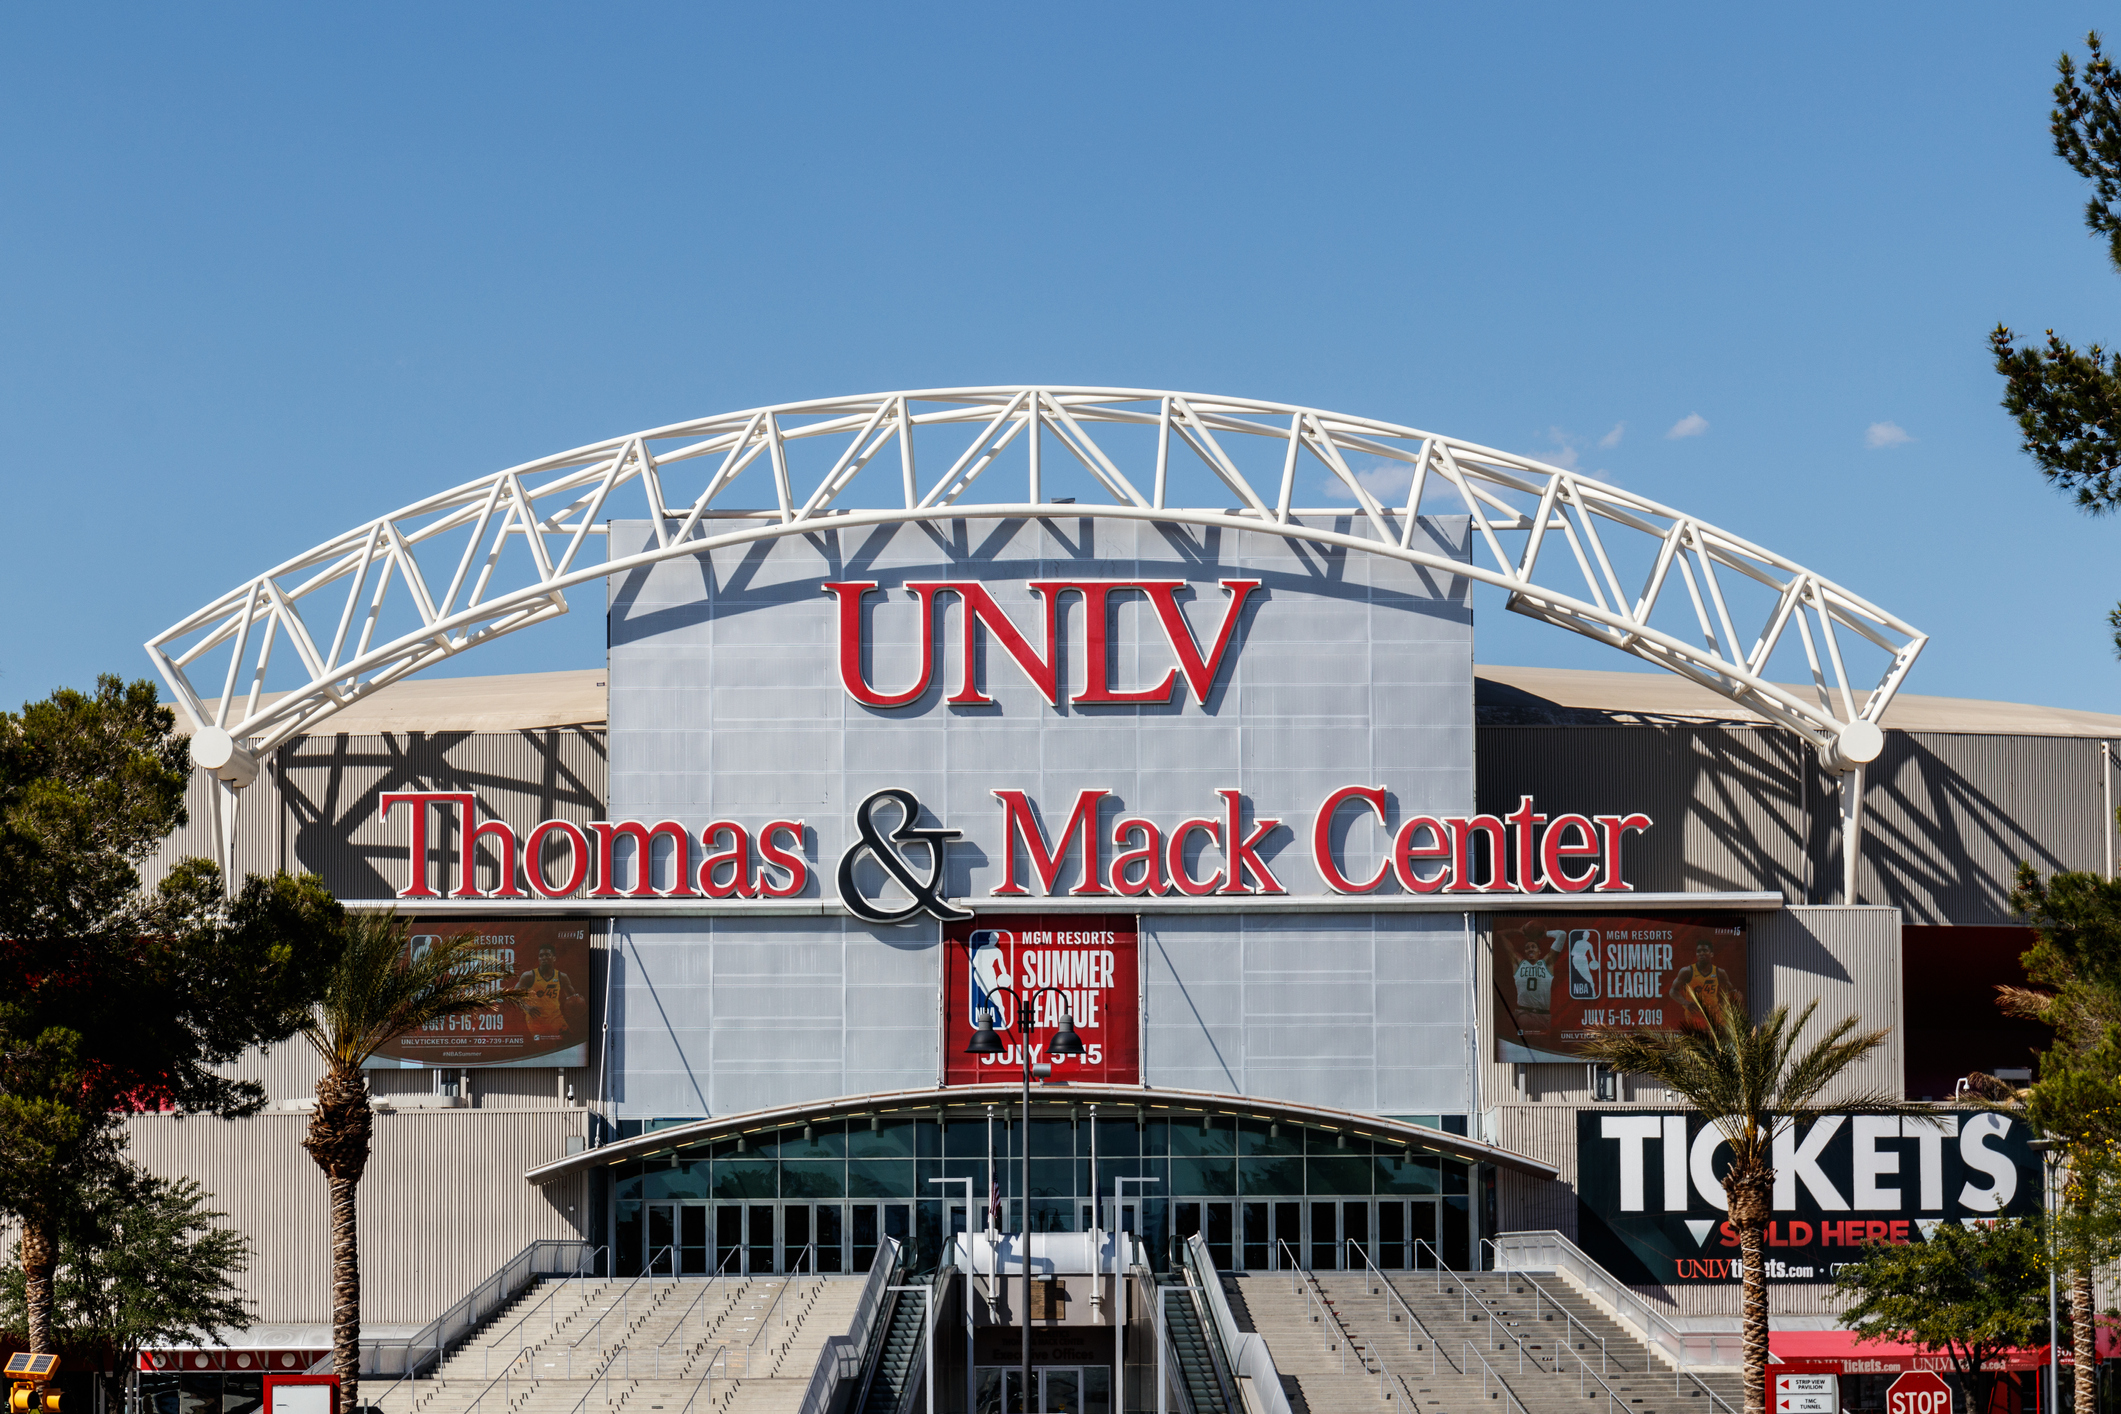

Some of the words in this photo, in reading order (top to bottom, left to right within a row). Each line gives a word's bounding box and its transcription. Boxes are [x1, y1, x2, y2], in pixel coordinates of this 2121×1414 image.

[820, 577, 1263, 708] UNLV
[378, 790, 809, 899] Thomas
[835, 786, 975, 924] &
[990, 787, 1287, 897] Mack
[1312, 784, 1653, 895] Center
[576, 930, 585, 940] 15
[1022, 931, 1052, 945] MGM
[1057, 931, 1115, 945] RESORTS
[1606, 930, 1629, 941] MGM
[1631, 930, 1673, 941] RESORTS
[1733, 926, 1741, 936] 15
[473, 935, 515, 945] RESORTS
[1606, 943, 1673, 971] SUMMER
[1021, 950, 1115, 988] SUMMER
[1520, 967, 1546, 978] CELTICS
[1526, 978, 1537, 991] 0
[1573, 983, 1589, 995] NBA
[1606, 971, 1663, 998] LEAGUE
[1703, 984, 1716, 994] 45
[546, 988, 558, 999] 45
[478, 1014, 503, 1031] 2019
[1581, 1009, 1605, 1026] JULY
[1608, 1009, 1635, 1027] 5-15,
[1637, 1009, 1663, 1026] 2019
[401, 1037, 467, 1045] UNLVTICKETS.COM
[473, 1037, 524, 1045] 702-739-FANS
[981, 1044, 1043, 1065] JULY
[1600, 1112, 2018, 1212] TICKETS
[1719, 1220, 1813, 1247] SLD
[1821, 1219, 1910, 1247] HERE
[1675, 1258, 1814, 1279] UNLVtiets.com
[1038, 1338, 1058, 1346] MACK
[1059, 1338, 1085, 1346] CENTER
[992, 1348, 1048, 1360] Execive
[1052, 1347, 1094, 1360] Offices
[1805, 1358, 1901, 1373] tickets.com
[1891, 1391, 1948, 1413] STOP
